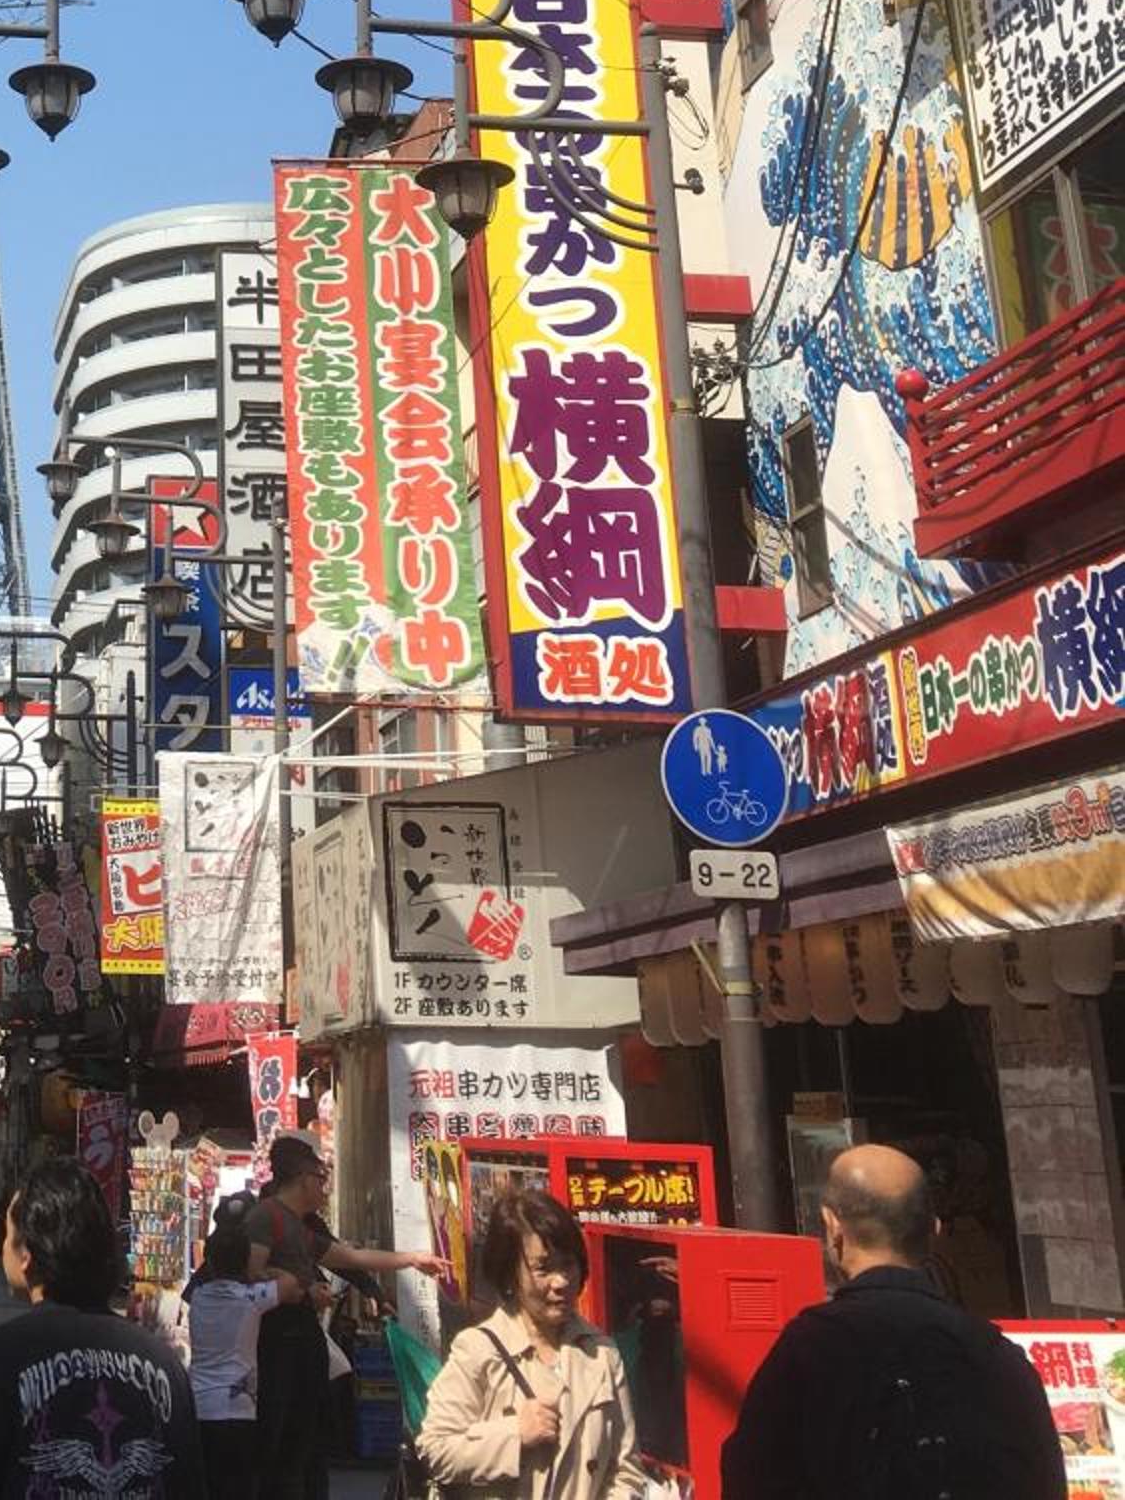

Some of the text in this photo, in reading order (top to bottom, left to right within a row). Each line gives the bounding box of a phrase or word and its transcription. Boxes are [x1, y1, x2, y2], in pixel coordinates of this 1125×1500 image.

[507, 346, 667, 628] 横綱
[538, 635, 672, 703] 酒処
[408, 1069, 602, 1101] 元祖串カツ専門店
